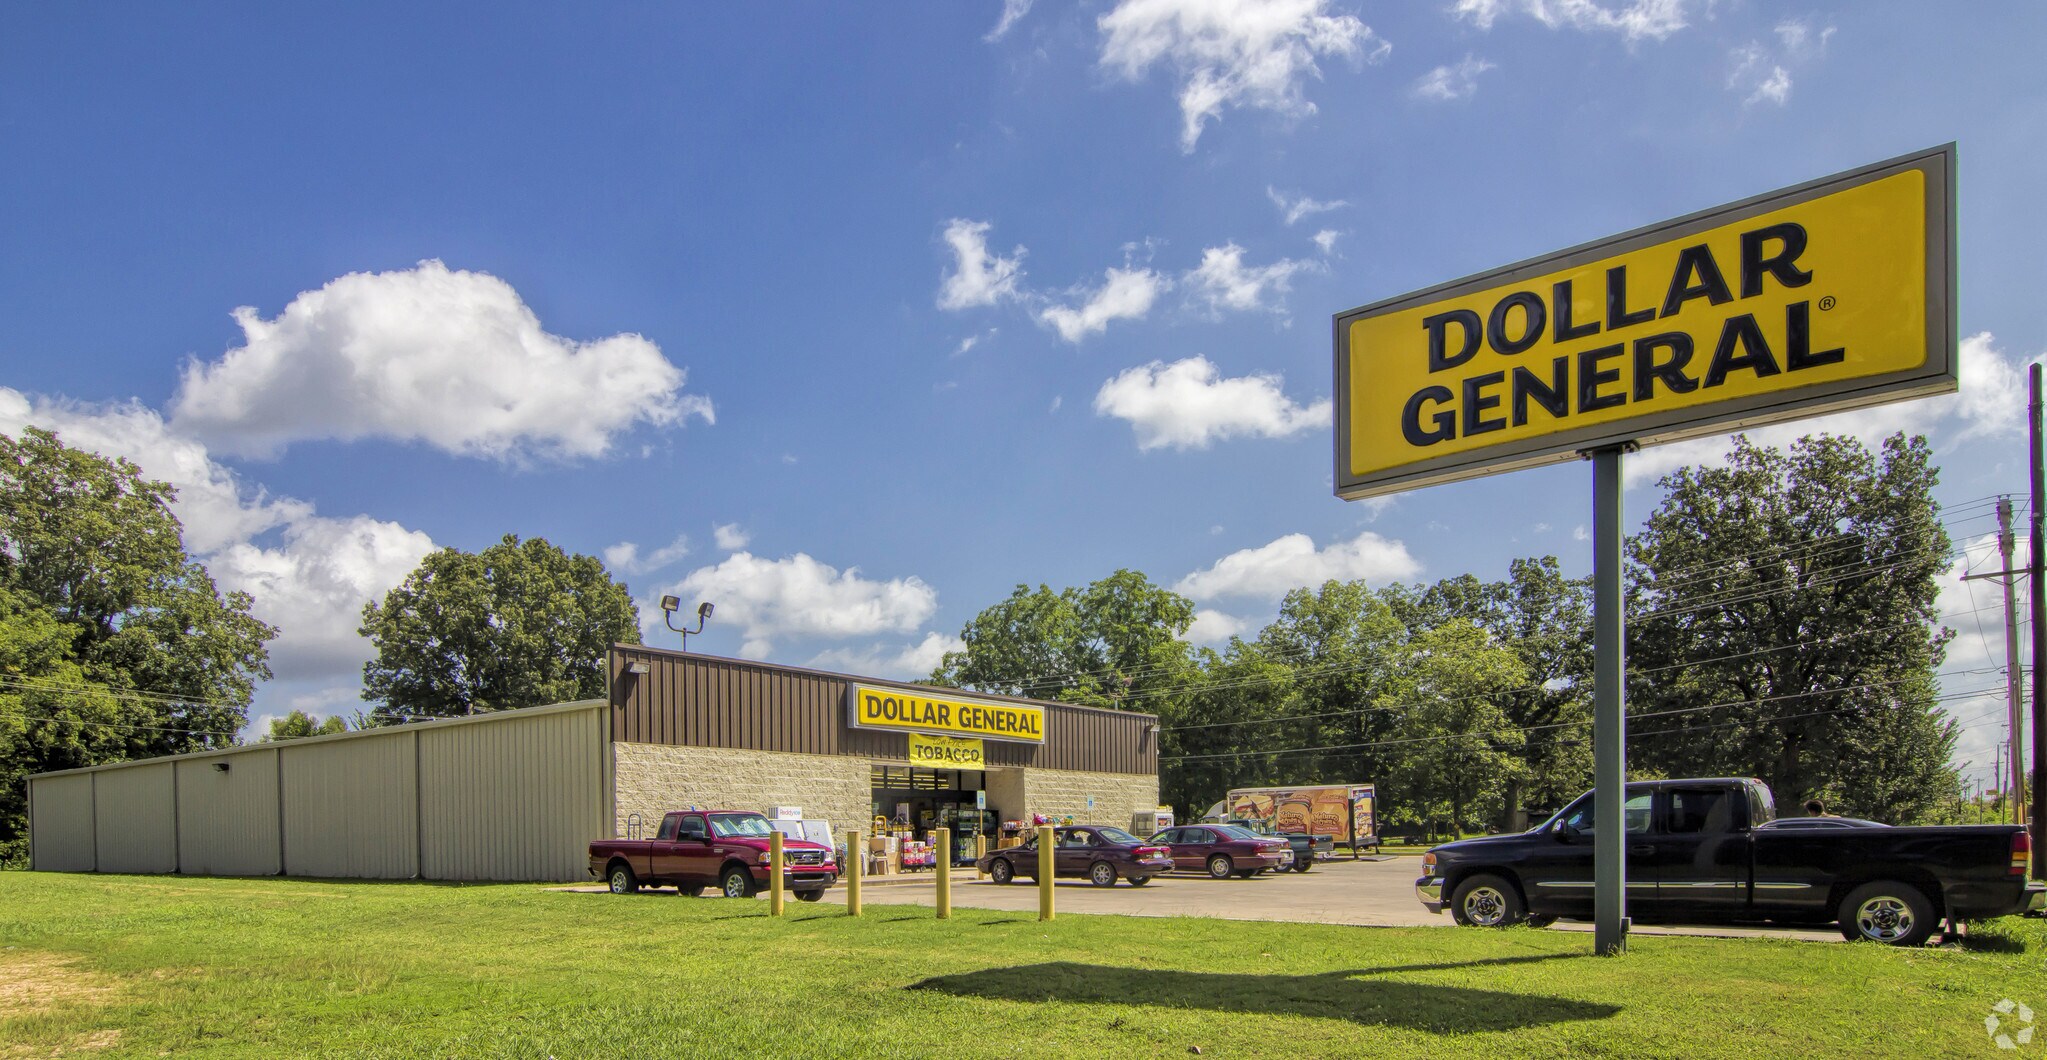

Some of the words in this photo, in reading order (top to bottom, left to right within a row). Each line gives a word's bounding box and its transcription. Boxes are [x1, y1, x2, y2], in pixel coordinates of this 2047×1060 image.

[1422, 222, 1814, 374] DOLLAR
[1401, 300, 1845, 447] GENERAL
[865, 695, 951, 726] DOLLAR
[958, 706, 1040, 735] GENERAL
[915, 744, 980, 762] TOBACCO
